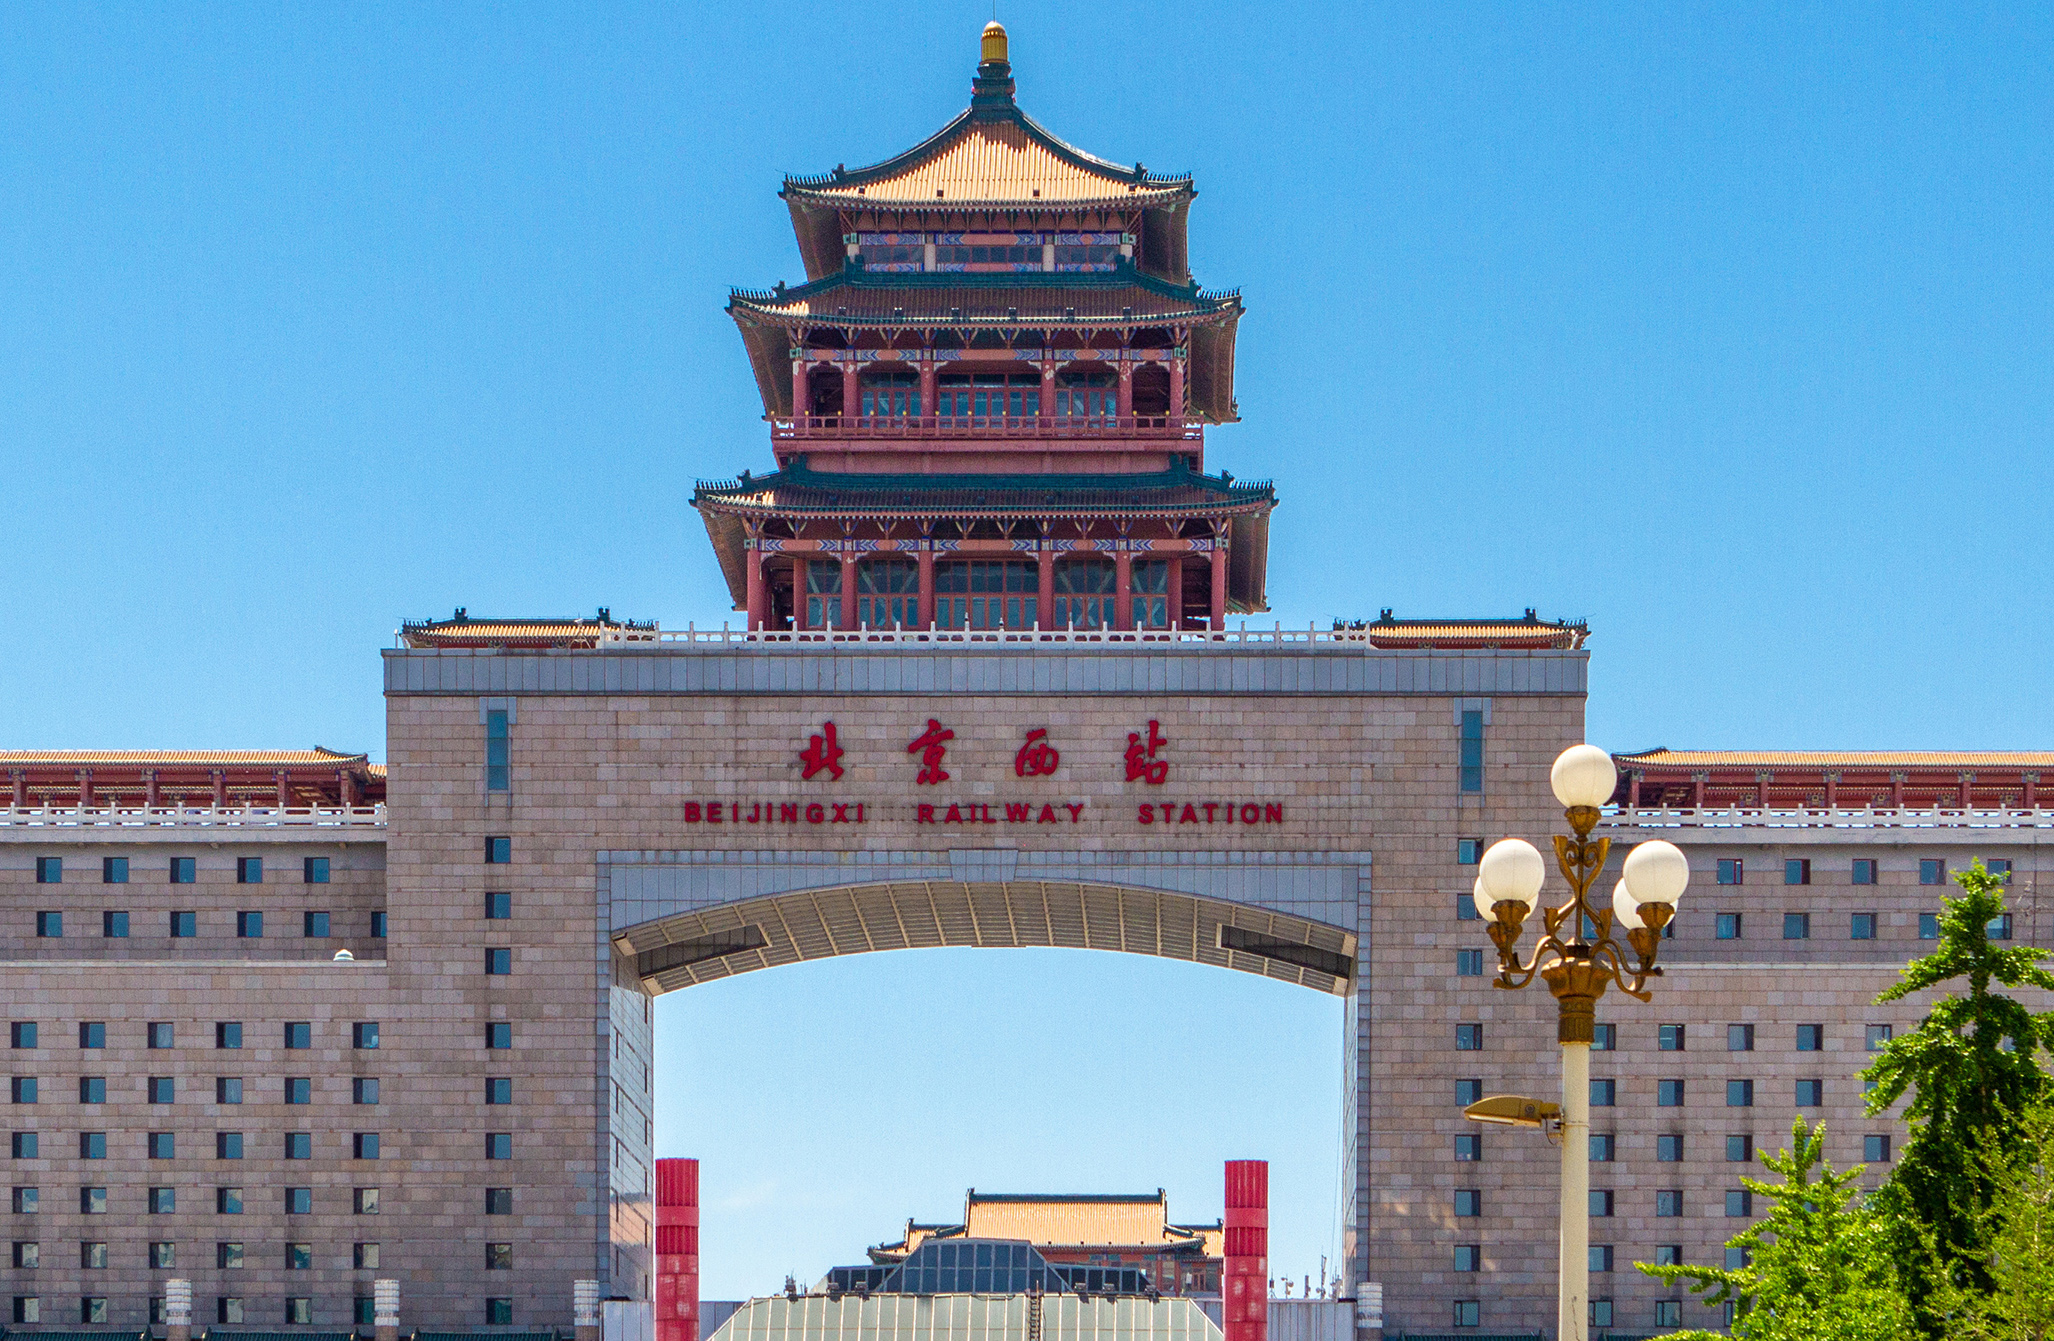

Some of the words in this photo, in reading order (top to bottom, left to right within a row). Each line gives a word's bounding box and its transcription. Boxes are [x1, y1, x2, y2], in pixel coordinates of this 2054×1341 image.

[799, 719, 1170, 786] 北京西站
[684, 802, 865, 825] BEIJINGXI
[916, 802, 1085, 825] RAILWAY
[1137, 802, 1284, 826] STATION
